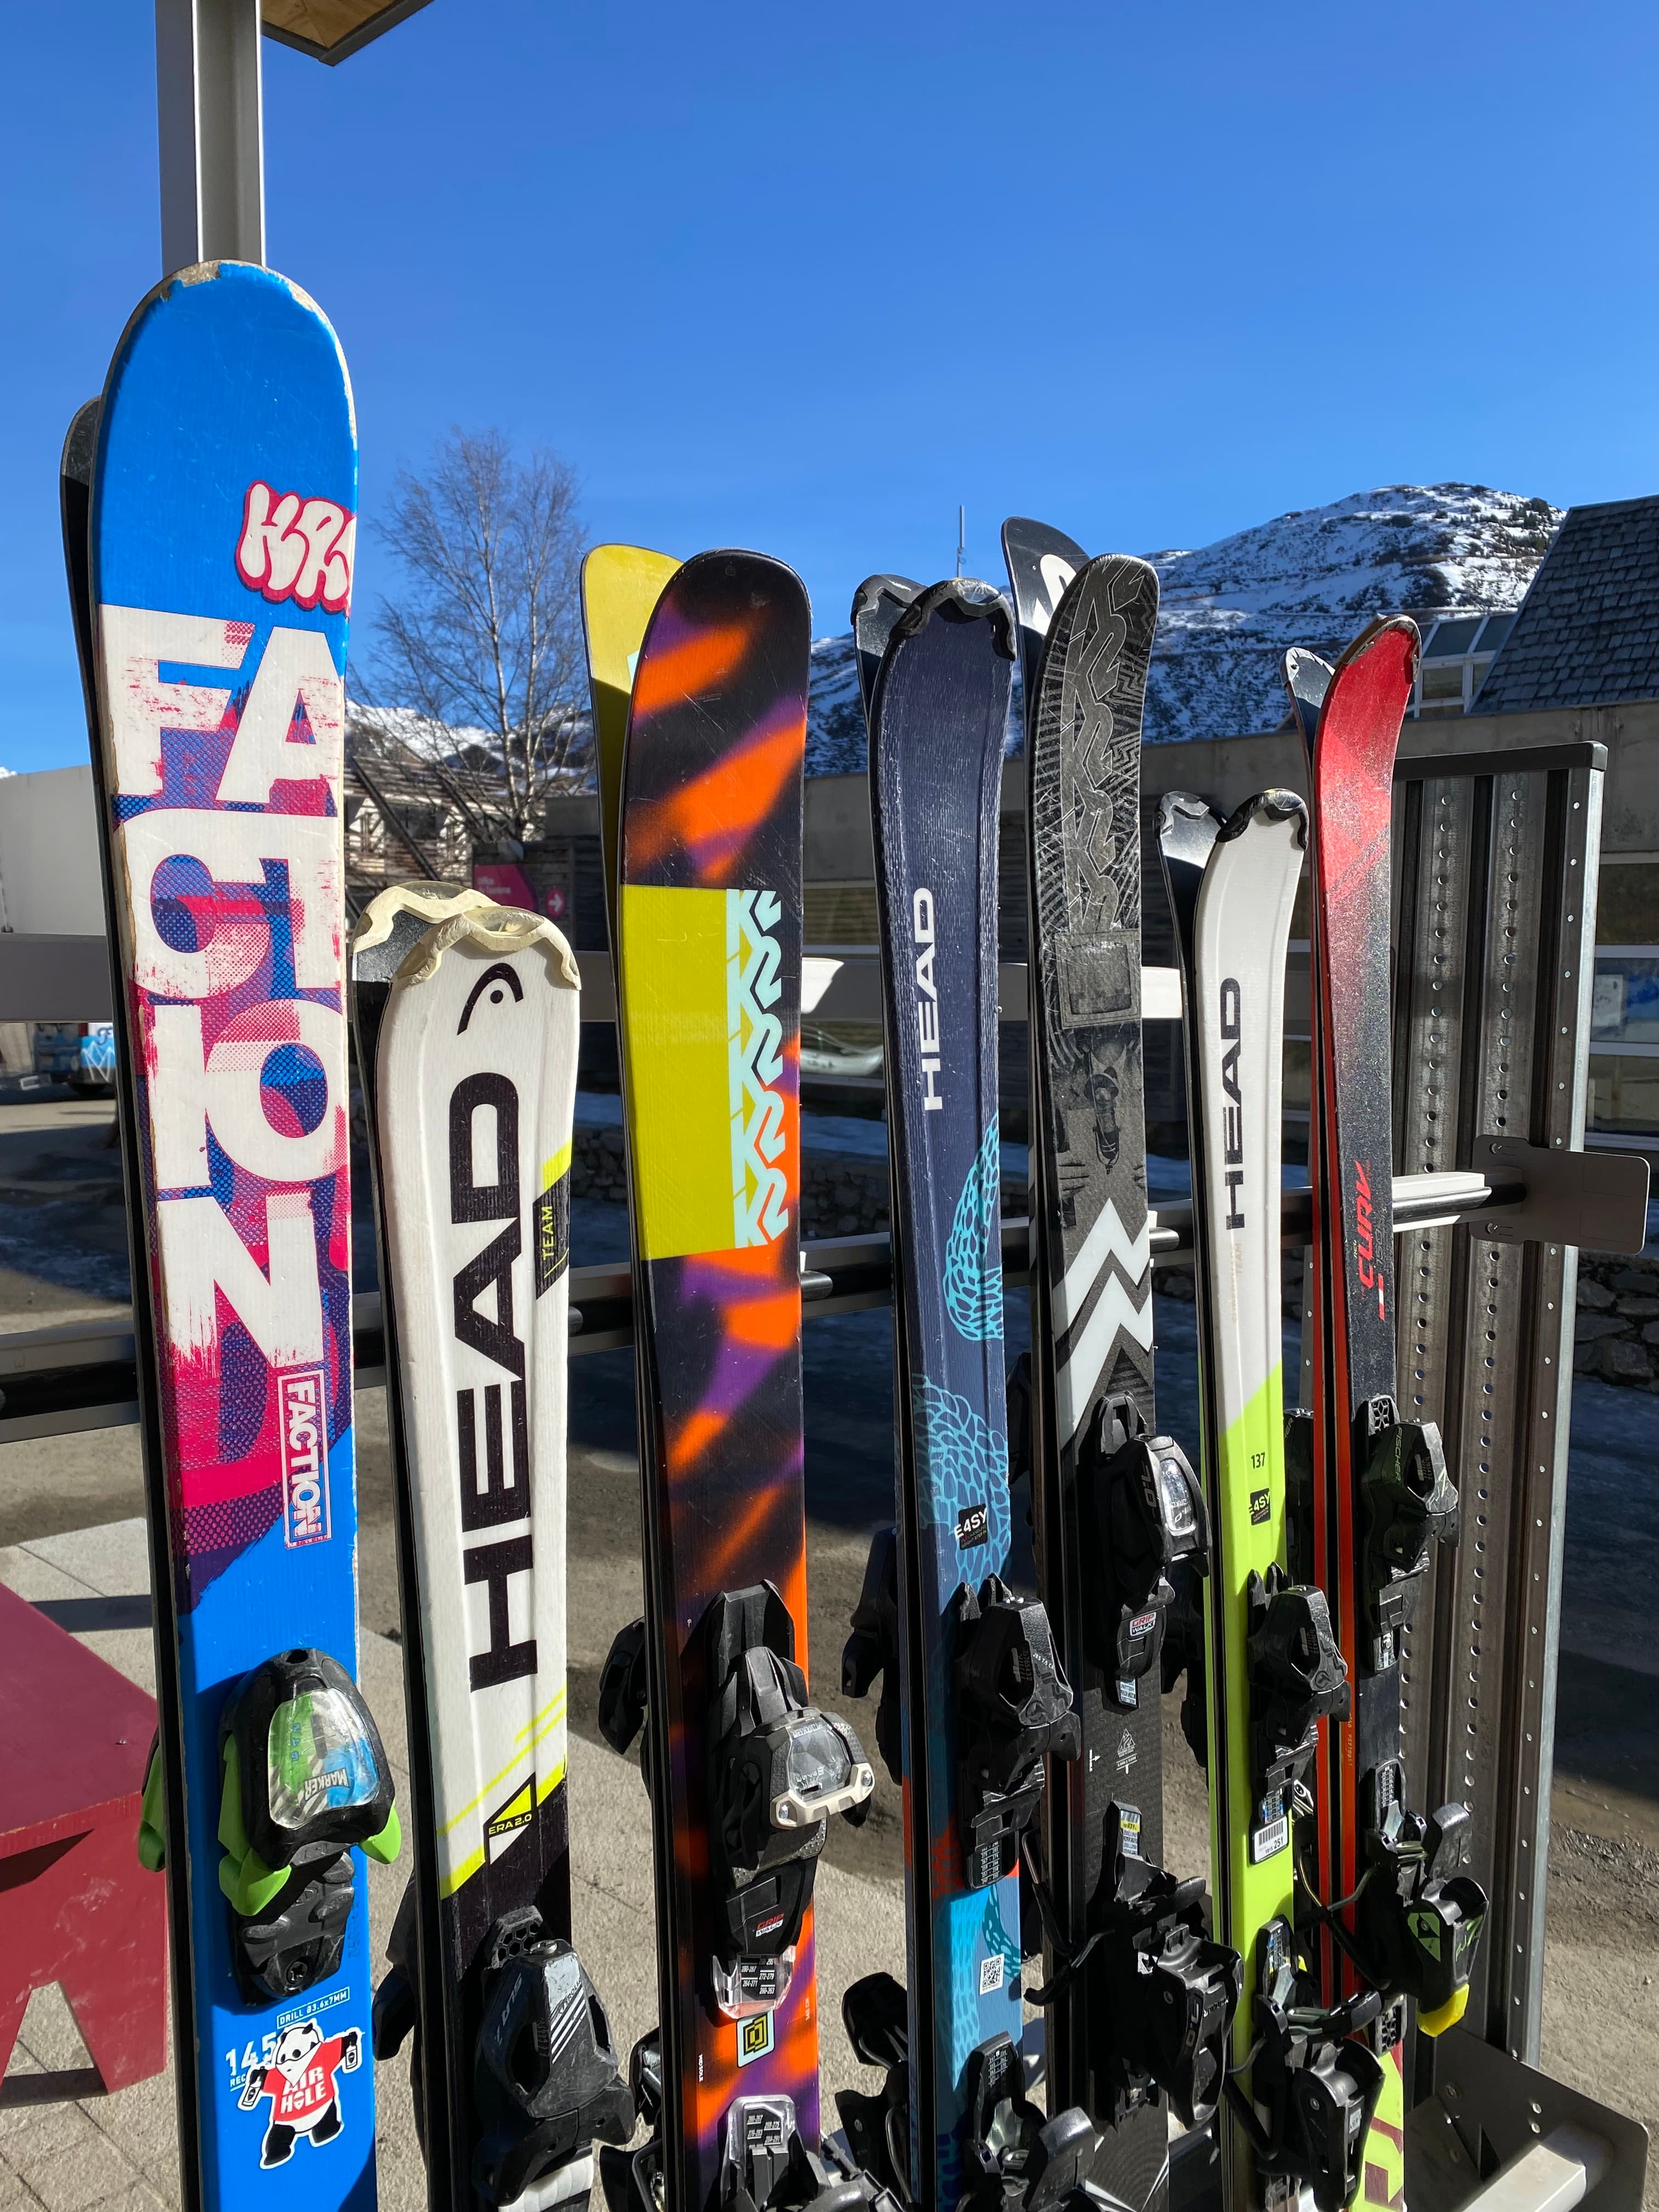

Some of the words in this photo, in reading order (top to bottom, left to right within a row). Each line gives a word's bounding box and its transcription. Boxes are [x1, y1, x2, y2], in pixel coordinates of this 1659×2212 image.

[913, 887, 943, 1110] HEAD
[1220, 977, 1245, 1230] HEAD
[543, 1205, 554, 1261] TEAM
[449, 1073, 538, 1693] HEAD
[286, 1379, 324, 1538] FACTION
[1251, 1452, 1265, 1469] 137
[1132, 1613, 1154, 1627] GRIP
[1132, 1621, 1153, 1634] WALK
[304, 1768, 349, 1801] MARKER
[488, 1821, 514, 1835] ERA
[515, 1813, 532, 1826] 2.0
[1273, 1836, 1284, 1849] 251
[757, 1913, 784, 1930] GRIP
[280, 2008, 304, 2025] DRILL
[225, 2031, 277, 2076] 145
[230, 2073, 247, 2087] REC
[282, 2066, 325, 2096] AIR
